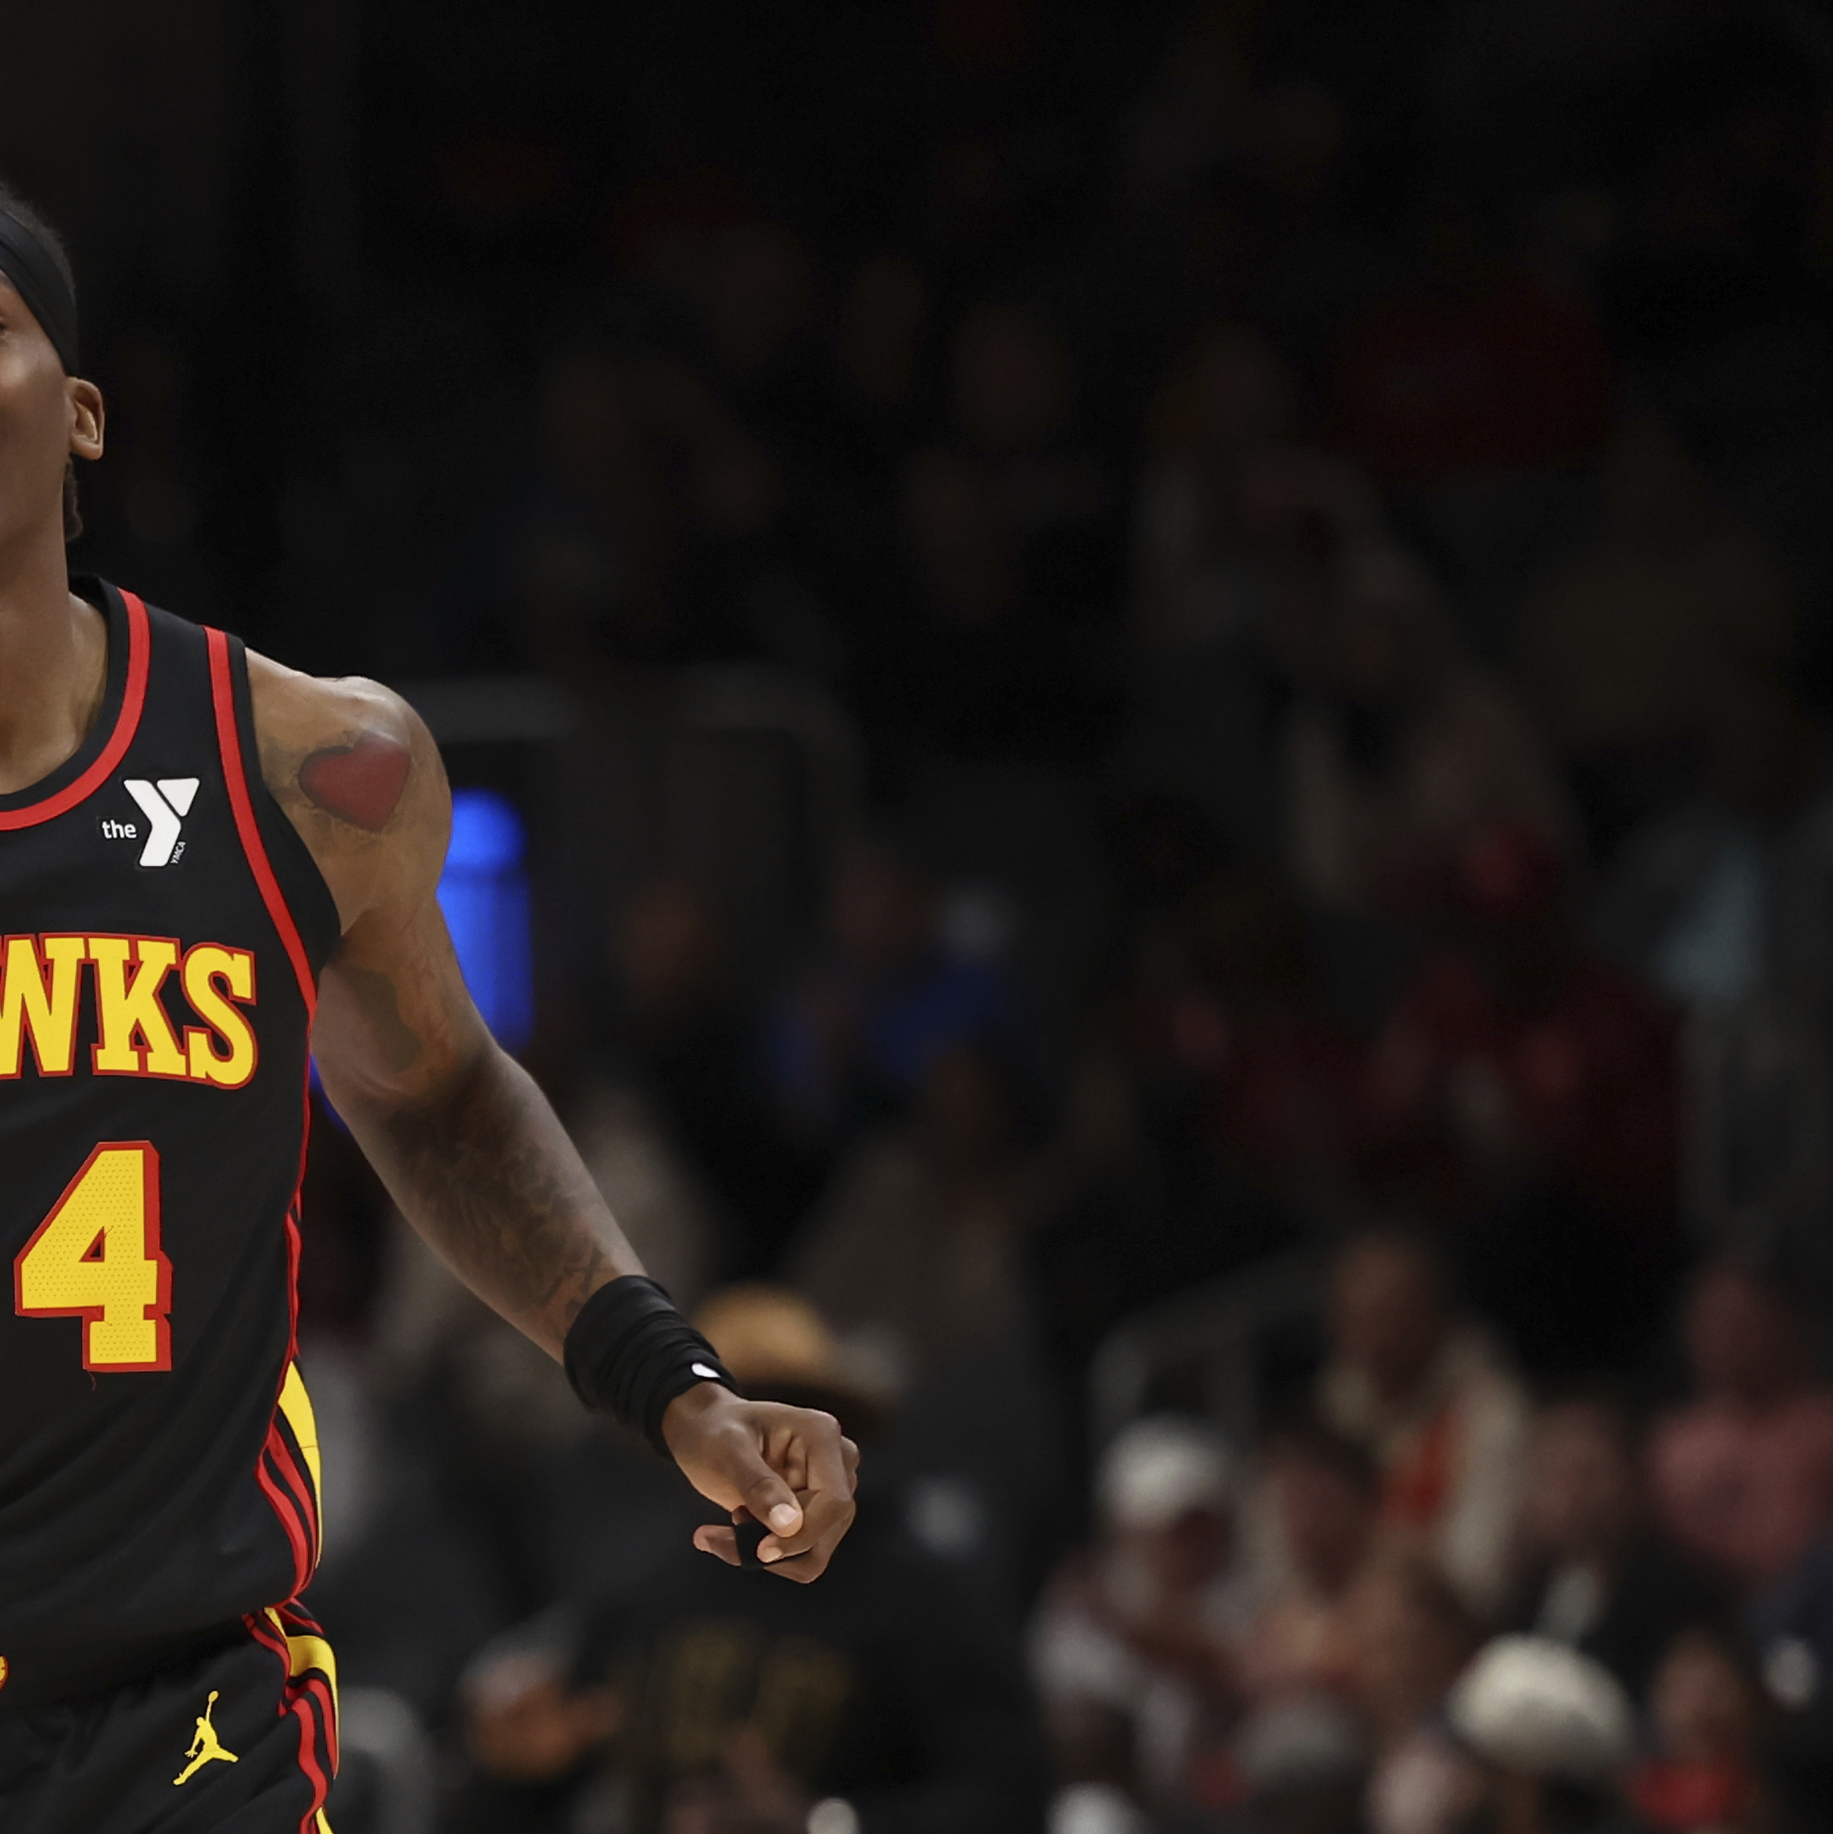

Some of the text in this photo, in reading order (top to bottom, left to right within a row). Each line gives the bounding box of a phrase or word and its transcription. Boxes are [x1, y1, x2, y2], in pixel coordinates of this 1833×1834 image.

[102, 777, 200, 867] the Y
[170, 841, 186, 864] YMCA
